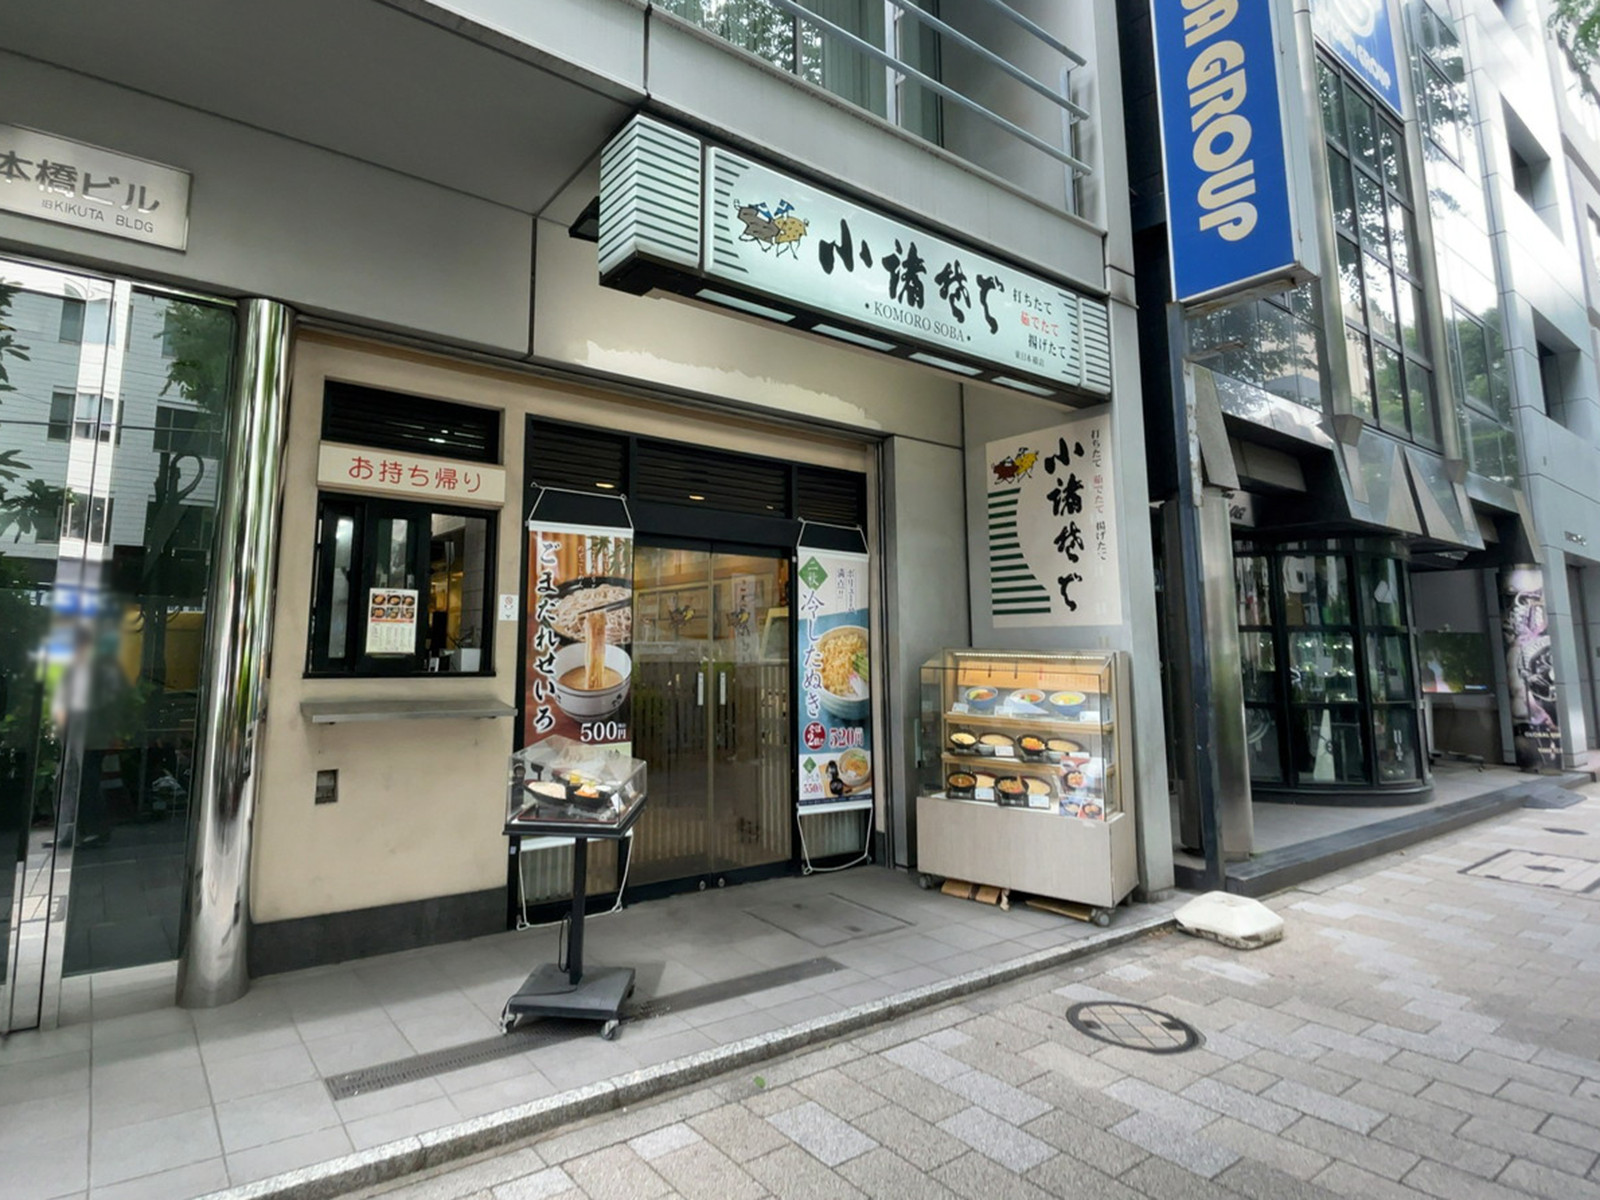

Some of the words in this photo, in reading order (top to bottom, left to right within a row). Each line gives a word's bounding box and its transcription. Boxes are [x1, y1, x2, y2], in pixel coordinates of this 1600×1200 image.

[115, 214, 154, 233] BLDG
[874, 301, 931, 331] KOMORO
[933, 320, 964, 342] SOBA
[348, 456, 481, 493] お持ち帰り
[533, 541, 560, 733] ごまだれせいろ
[800, 590, 825, 718] 冷したぬき
